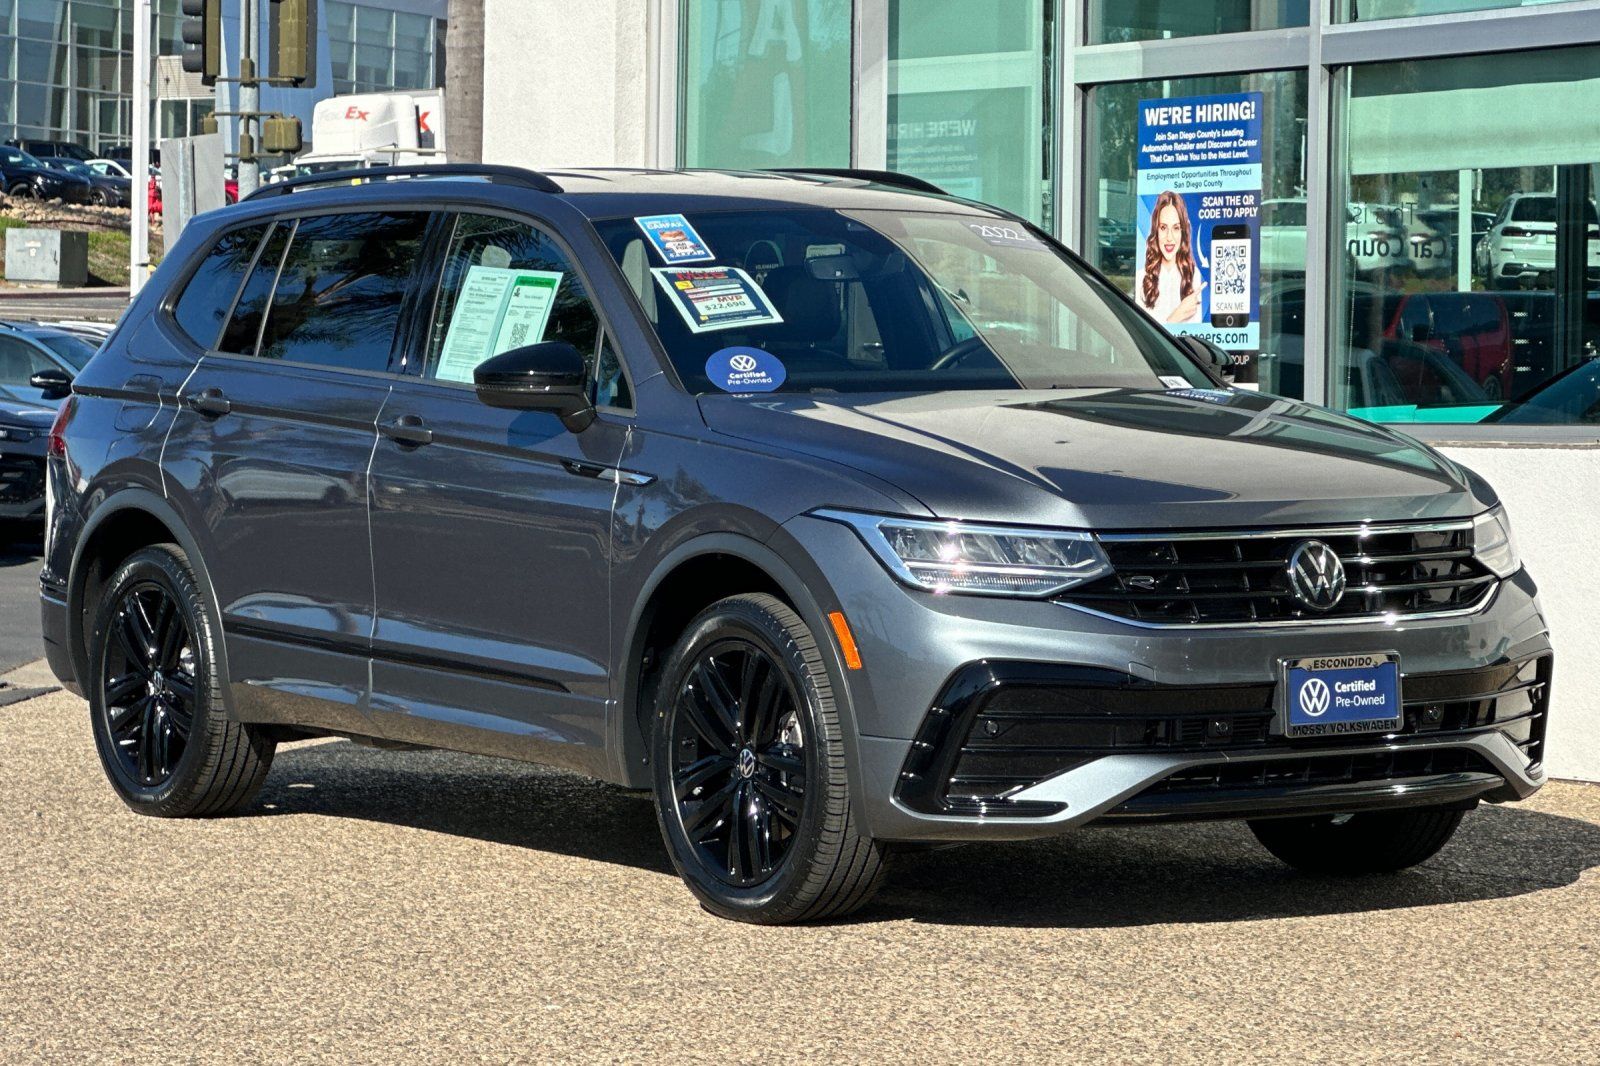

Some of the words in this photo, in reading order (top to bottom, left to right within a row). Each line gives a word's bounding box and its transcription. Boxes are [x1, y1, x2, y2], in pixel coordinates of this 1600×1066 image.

[1144, 105, 1192, 126] WE'RE
[1195, 101, 1256, 123] HIRING!
[1154, 132, 1167, 141] Join
[1167, 131, 1178, 140] San
[1179, 130, 1196, 140] Diego
[1196, 129, 1221, 139] County's
[1221, 128, 1244, 138] Leading
[1142, 143, 1173, 153] Automotive
[1173, 142, 1195, 151] Retailer
[1195, 141, 1207, 149] and
[1207, 139, 1232, 149] Discover
[1237, 138, 1258, 147] Career
[1149, 153, 1163, 163] That
[1163, 153, 1174, 162] Can
[1175, 153, 1188, 161] Take
[1189, 152, 1200, 161] You
[1200, 152, 1208, 160] to
[1207, 151, 1218, 160] the
[1218, 150, 1232, 159] Next
[1146, 171, 1180, 181] Employment
[1181, 169, 1219, 180] Opportunities
[1220, 168, 1252, 178] Throughout
[1174, 181, 1185, 189] San
[1186, 180, 1202, 189] Diego
[1203, 179, 1224, 188] County
[1202, 195, 1224, 207] SCAN
[1225, 195, 1241, 206] THE
[1242, 194, 1255, 205] QR
[1198, 208, 1221, 219] CODE
[1222, 207, 1233, 218] TO
[1233, 206, 1258, 218] APPLY
[716, 295, 743, 303] MVP
[1215, 302, 1232, 311] SCAN
[1234, 302, 1244, 311] ME
[727, 377, 772, 386] Pre-Owned
[729, 371, 766, 379] Certified
[1313, 656, 1372, 669] ESCONDIDO
[1334, 679, 1376, 693] Certified
[1335, 693, 1385, 707] Pre-Owned
[1292, 724, 1328, 736] MOSSY
[1330, 720, 1397, 733] VOLKSWAGEN
